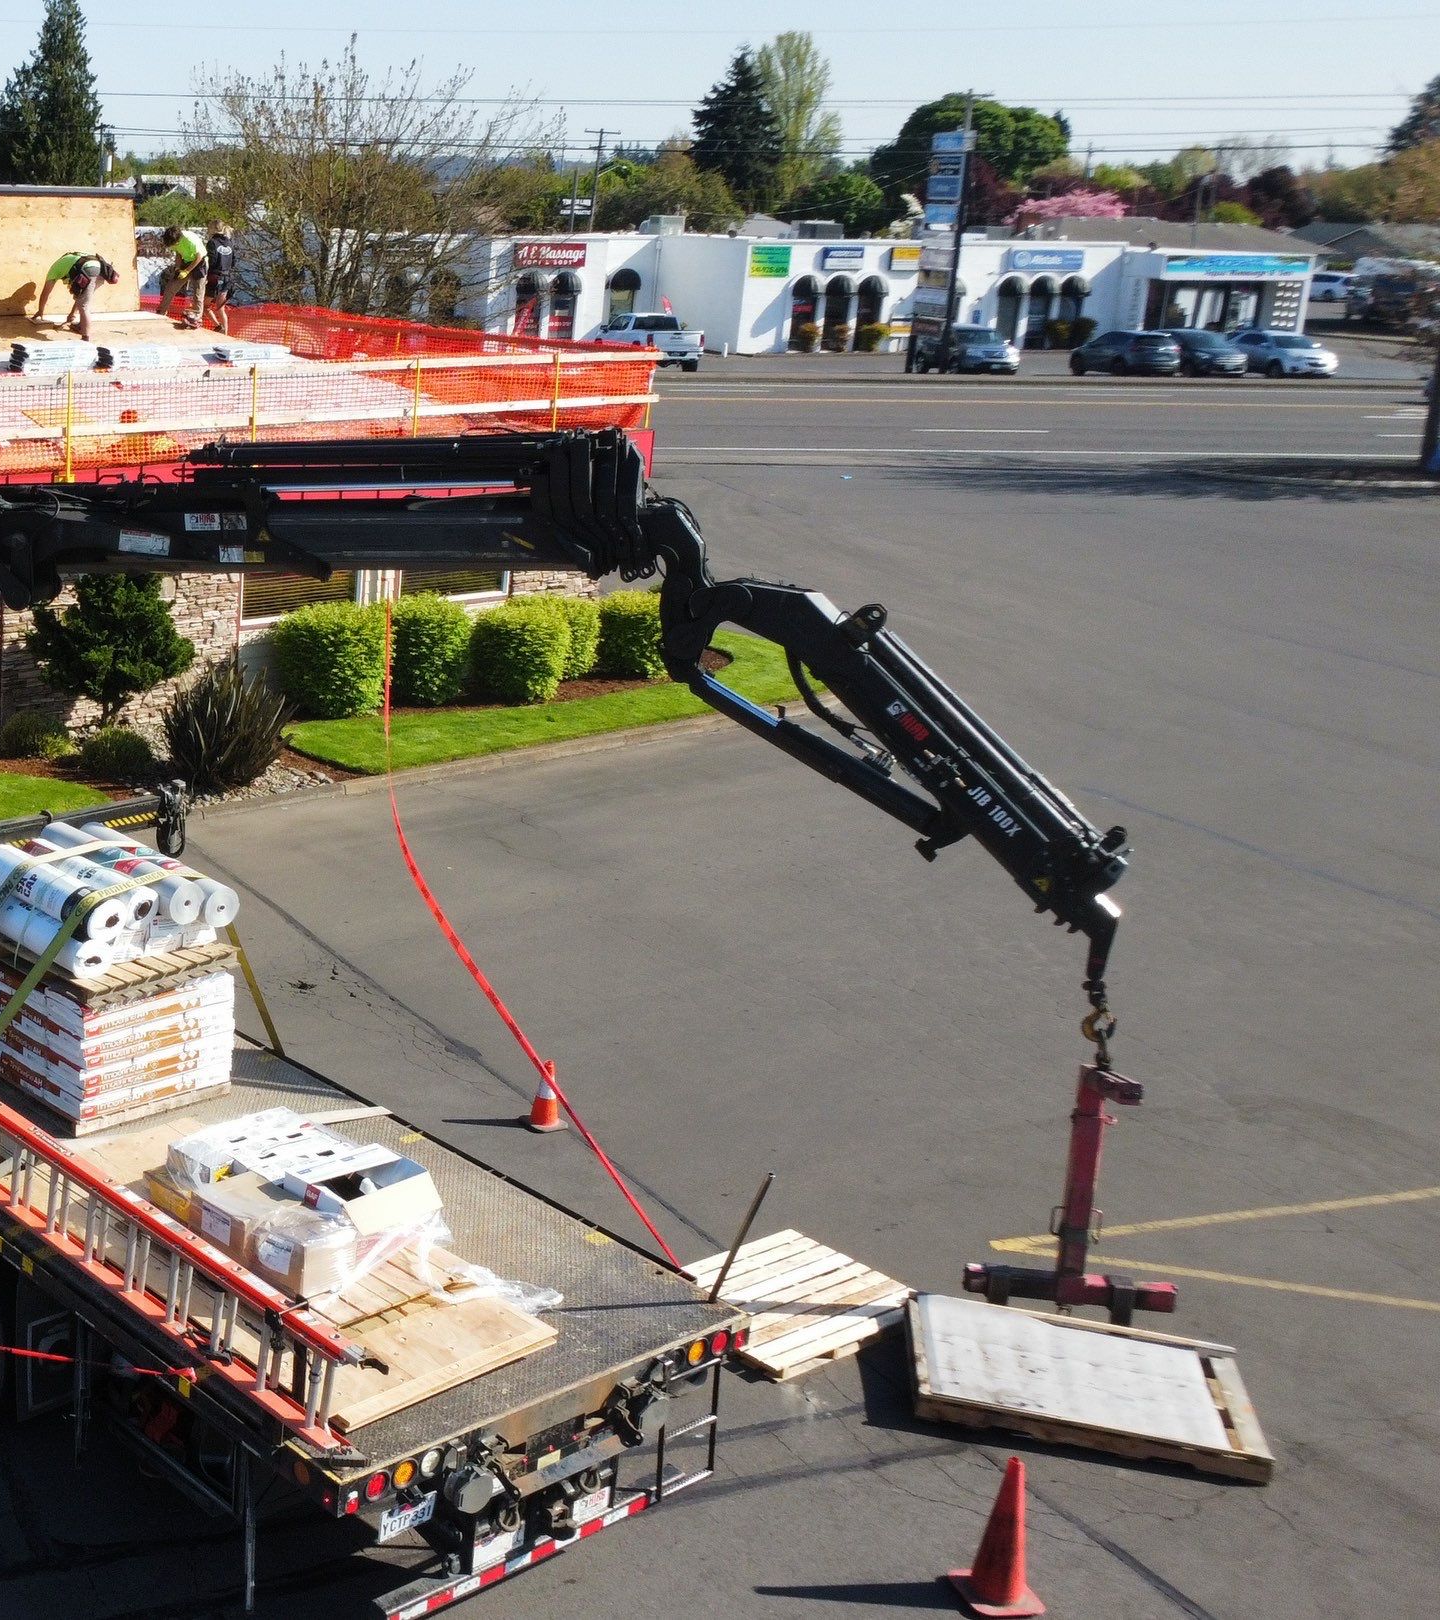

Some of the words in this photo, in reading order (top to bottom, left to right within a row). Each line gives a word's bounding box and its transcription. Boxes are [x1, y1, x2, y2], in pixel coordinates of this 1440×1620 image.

[540, 245, 586, 263] Massage
[967, 786, 993, 807] JIB
[988, 804, 1022, 838] 100X
[23, 873, 38, 898] CAP
[134, 869, 166, 886] CARGO
